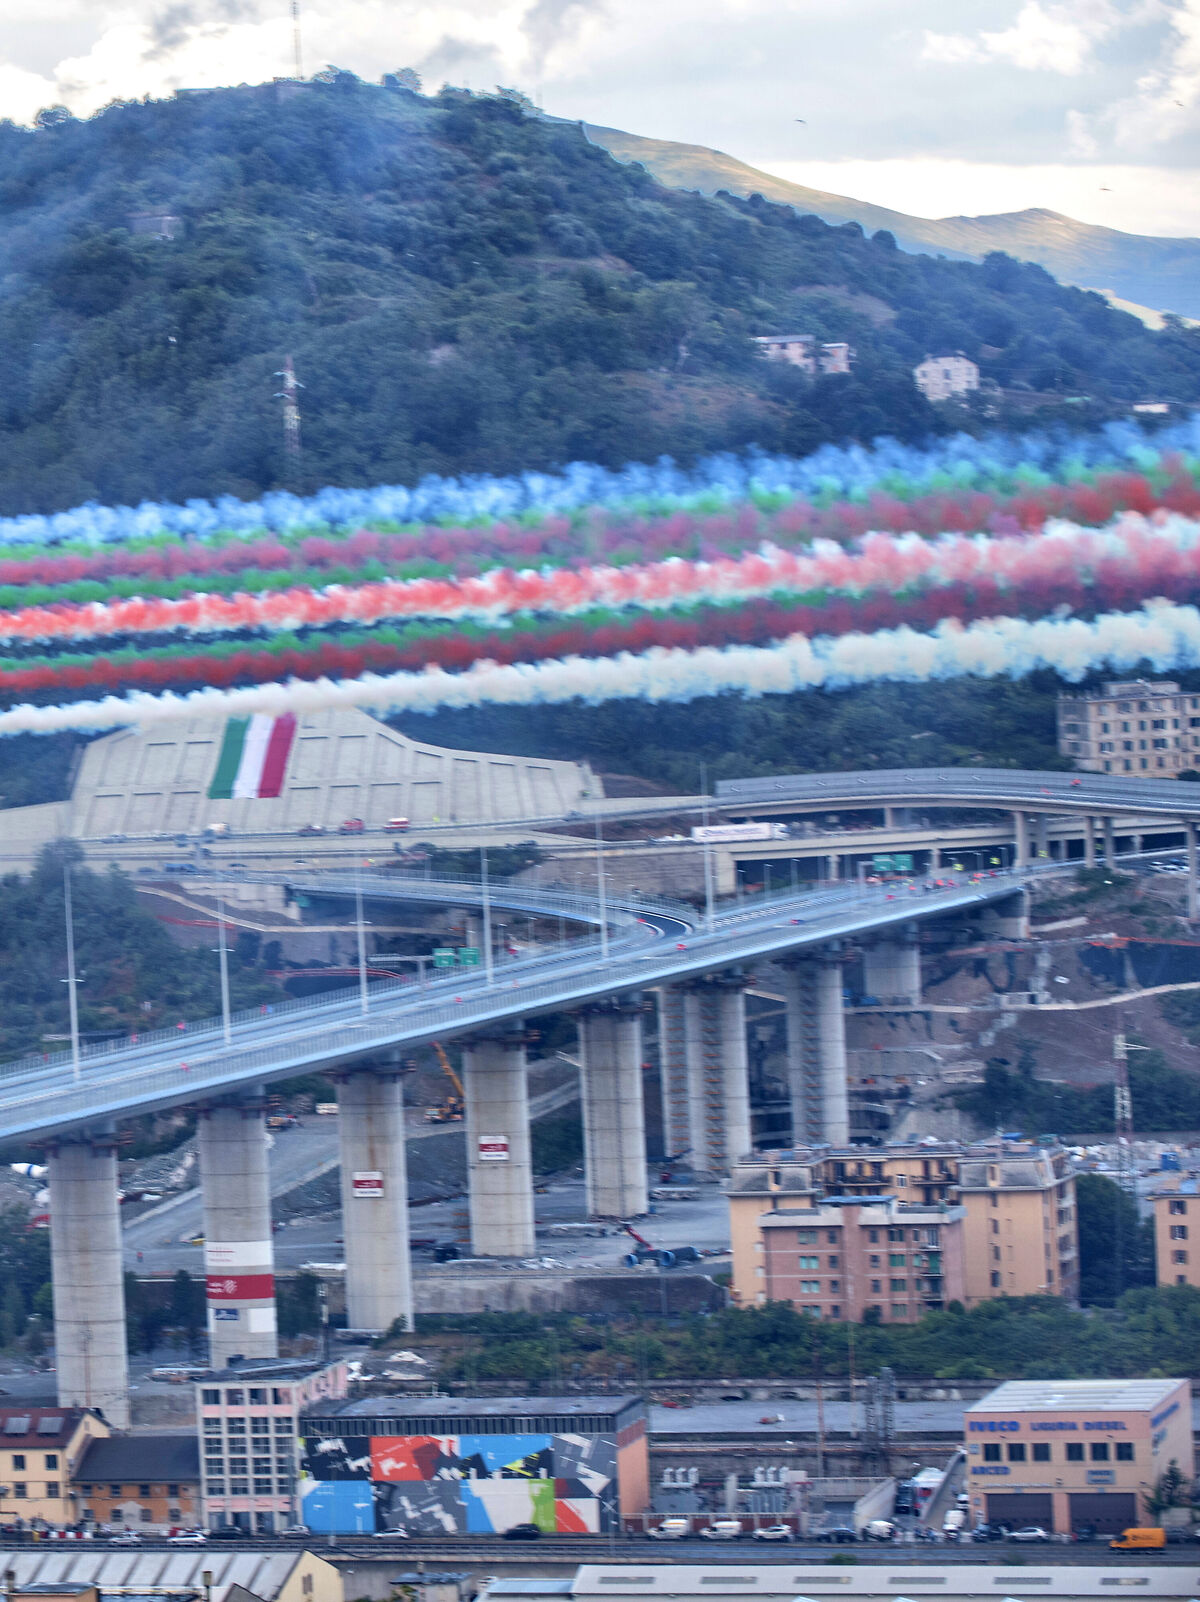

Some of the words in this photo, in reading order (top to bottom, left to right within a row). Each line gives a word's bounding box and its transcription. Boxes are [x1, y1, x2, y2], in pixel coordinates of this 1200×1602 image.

[969, 1421, 1020, 1432] IVECO
[1030, 1422, 1078, 1431] LIGURIA
[1083, 1421, 1128, 1431] DIESEL
